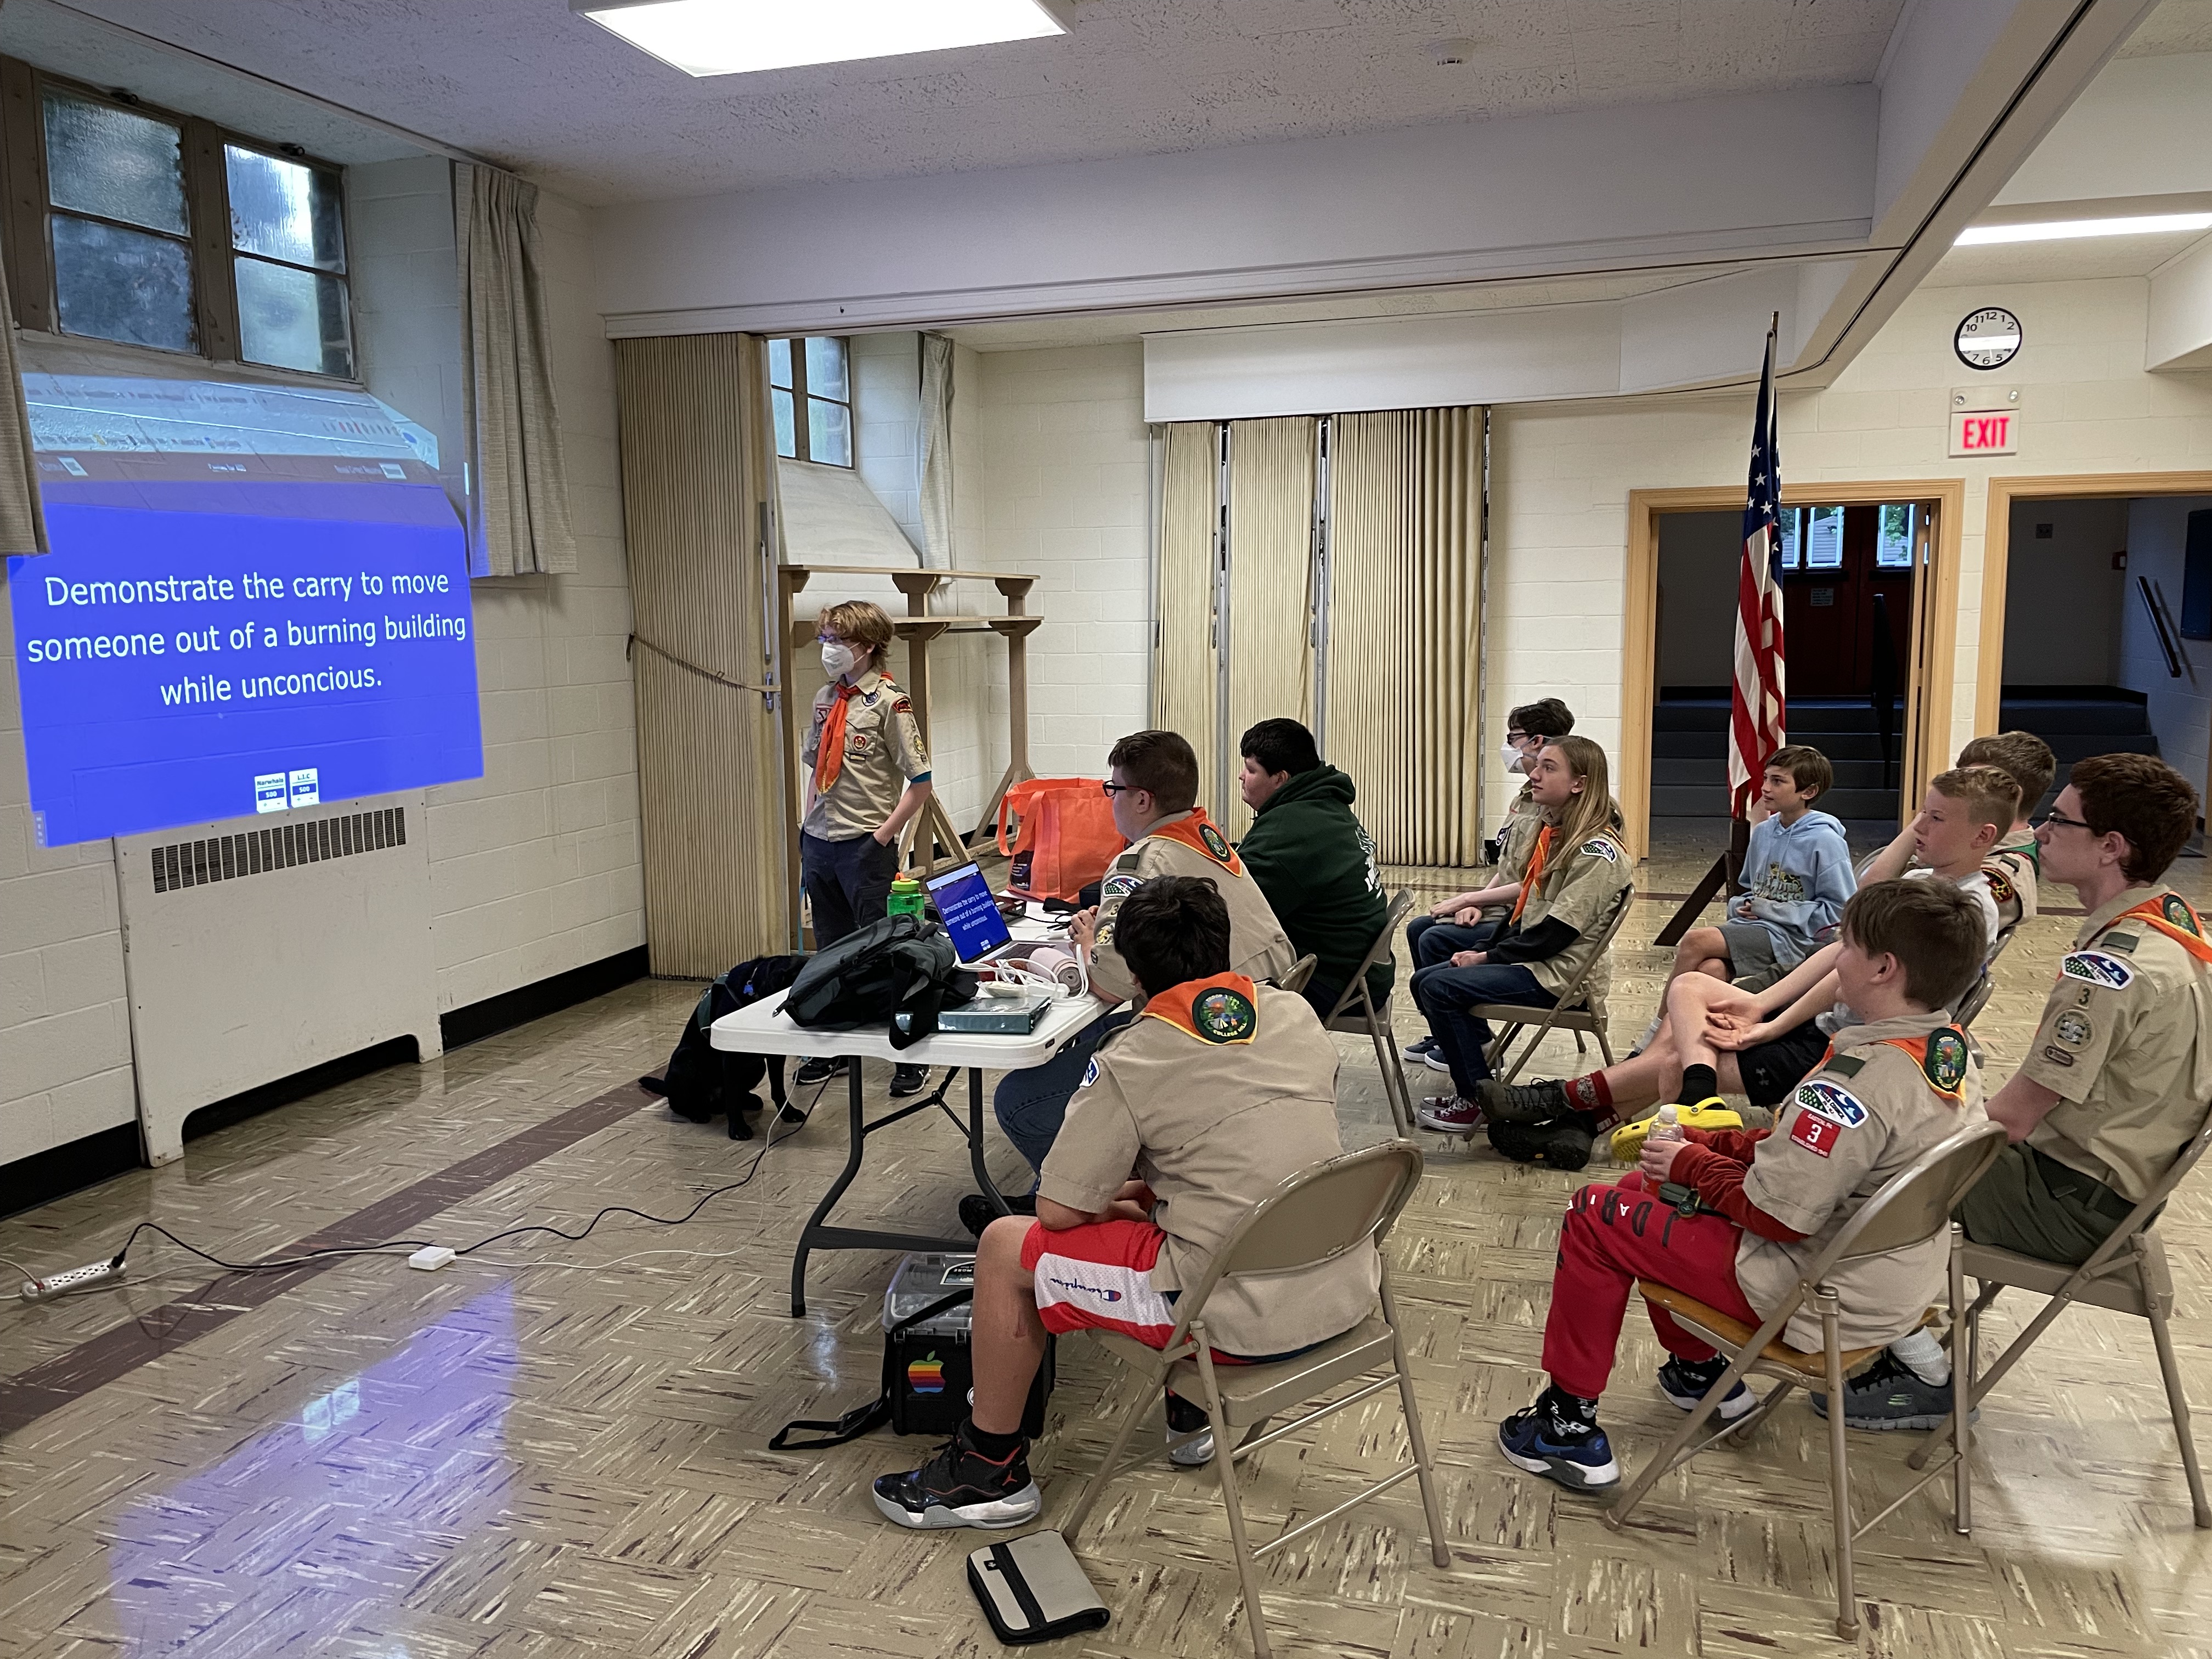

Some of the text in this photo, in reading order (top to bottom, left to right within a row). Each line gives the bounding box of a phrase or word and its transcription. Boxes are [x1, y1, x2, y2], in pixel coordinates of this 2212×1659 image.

[1985, 312, 1997, 320] 12
[1962, 416, 2010, 449] EXIT
[45, 572, 449, 606] Demonstrate the carry to move
[27, 613, 465, 662] someone out of a burning building
[160, 666, 382, 706] while unconcious.
[257, 777, 284, 786] Narwhals
[1110, 904, 1119, 915] 3
[2079, 988, 2090, 1005] 3
[1807, 1124, 1822, 1143] 3
[1050, 1278, 1121, 1302] Champion
